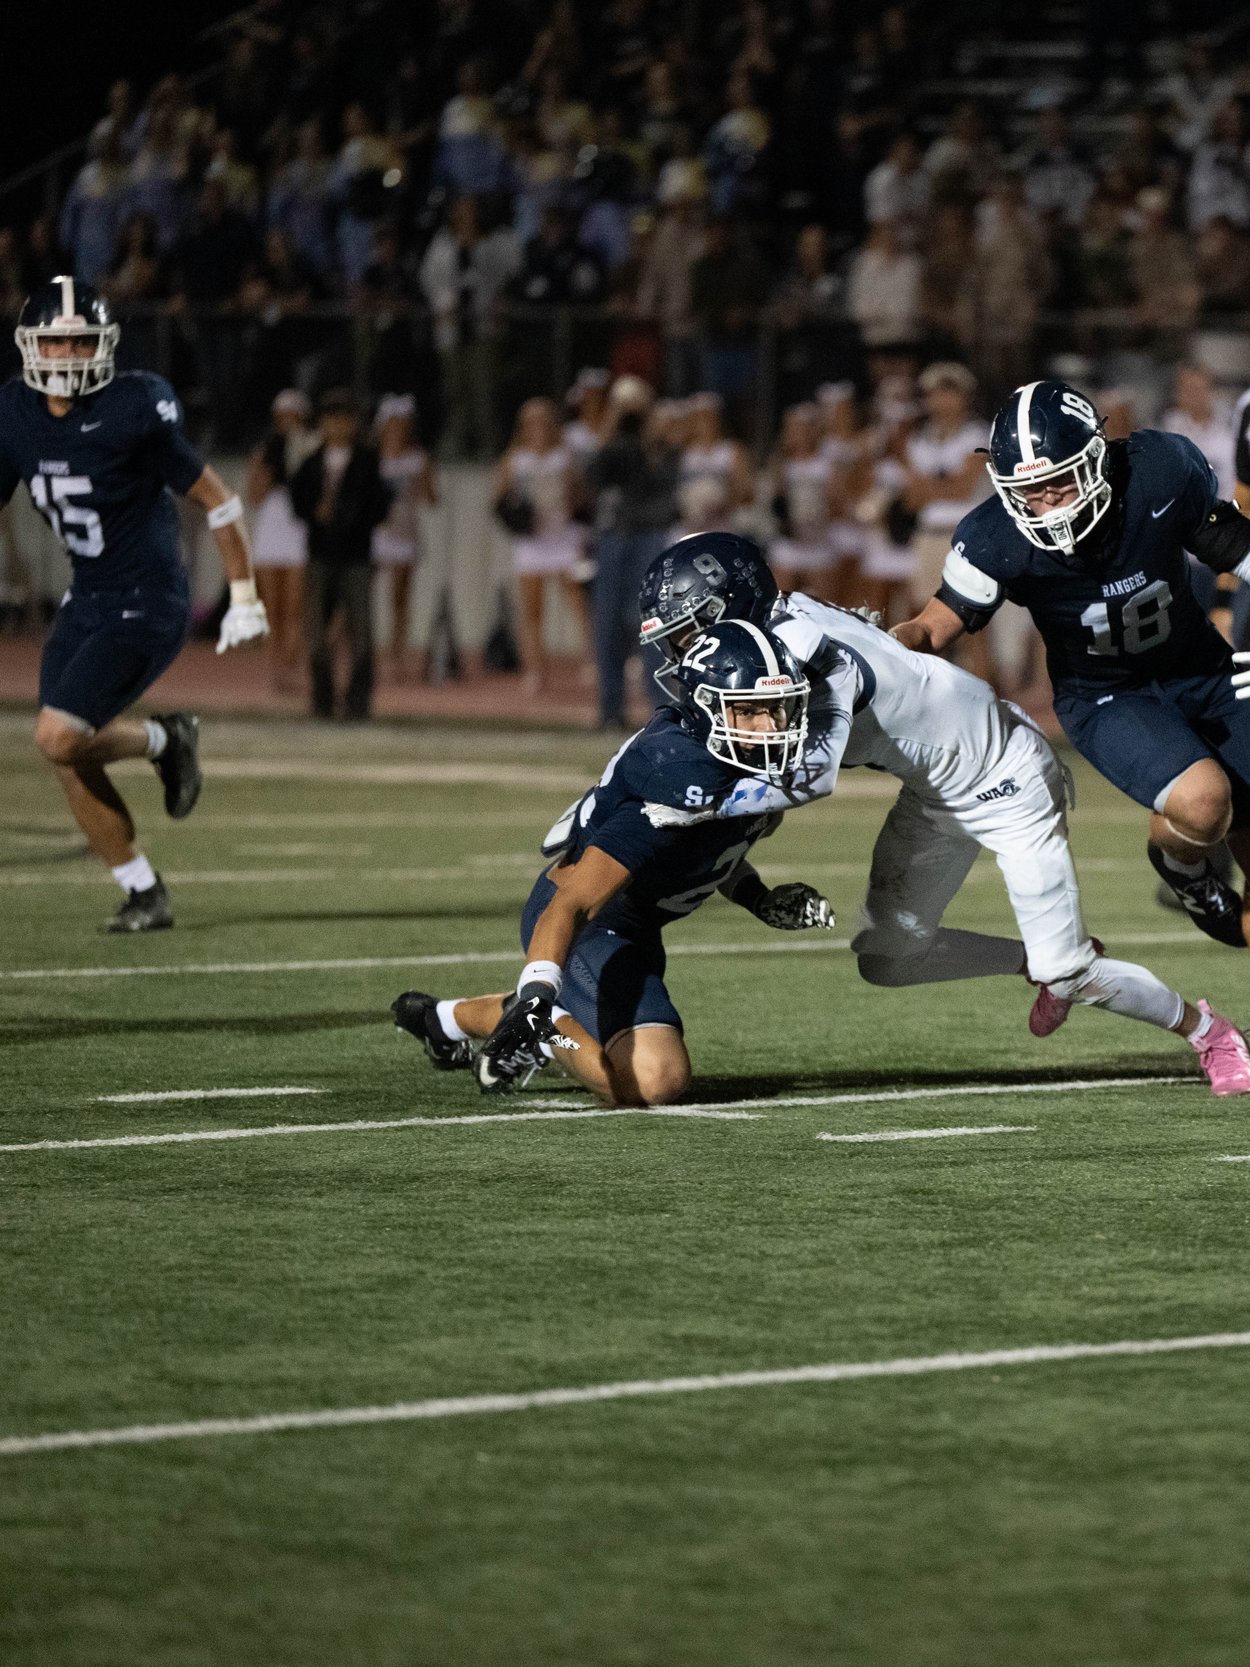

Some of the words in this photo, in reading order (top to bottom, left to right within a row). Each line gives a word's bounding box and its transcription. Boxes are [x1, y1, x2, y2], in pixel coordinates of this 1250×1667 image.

[1060, 392, 1099, 431] 18
[1017, 459, 1048, 474] Riddell
[31, 473, 105, 558] 15
[692, 552, 728, 586] 9
[1101, 570, 1148, 598] RANGERS
[1080, 579, 1174, 657] 18
[681, 633, 721, 673] 22
[760, 677, 793, 687] Riddell
